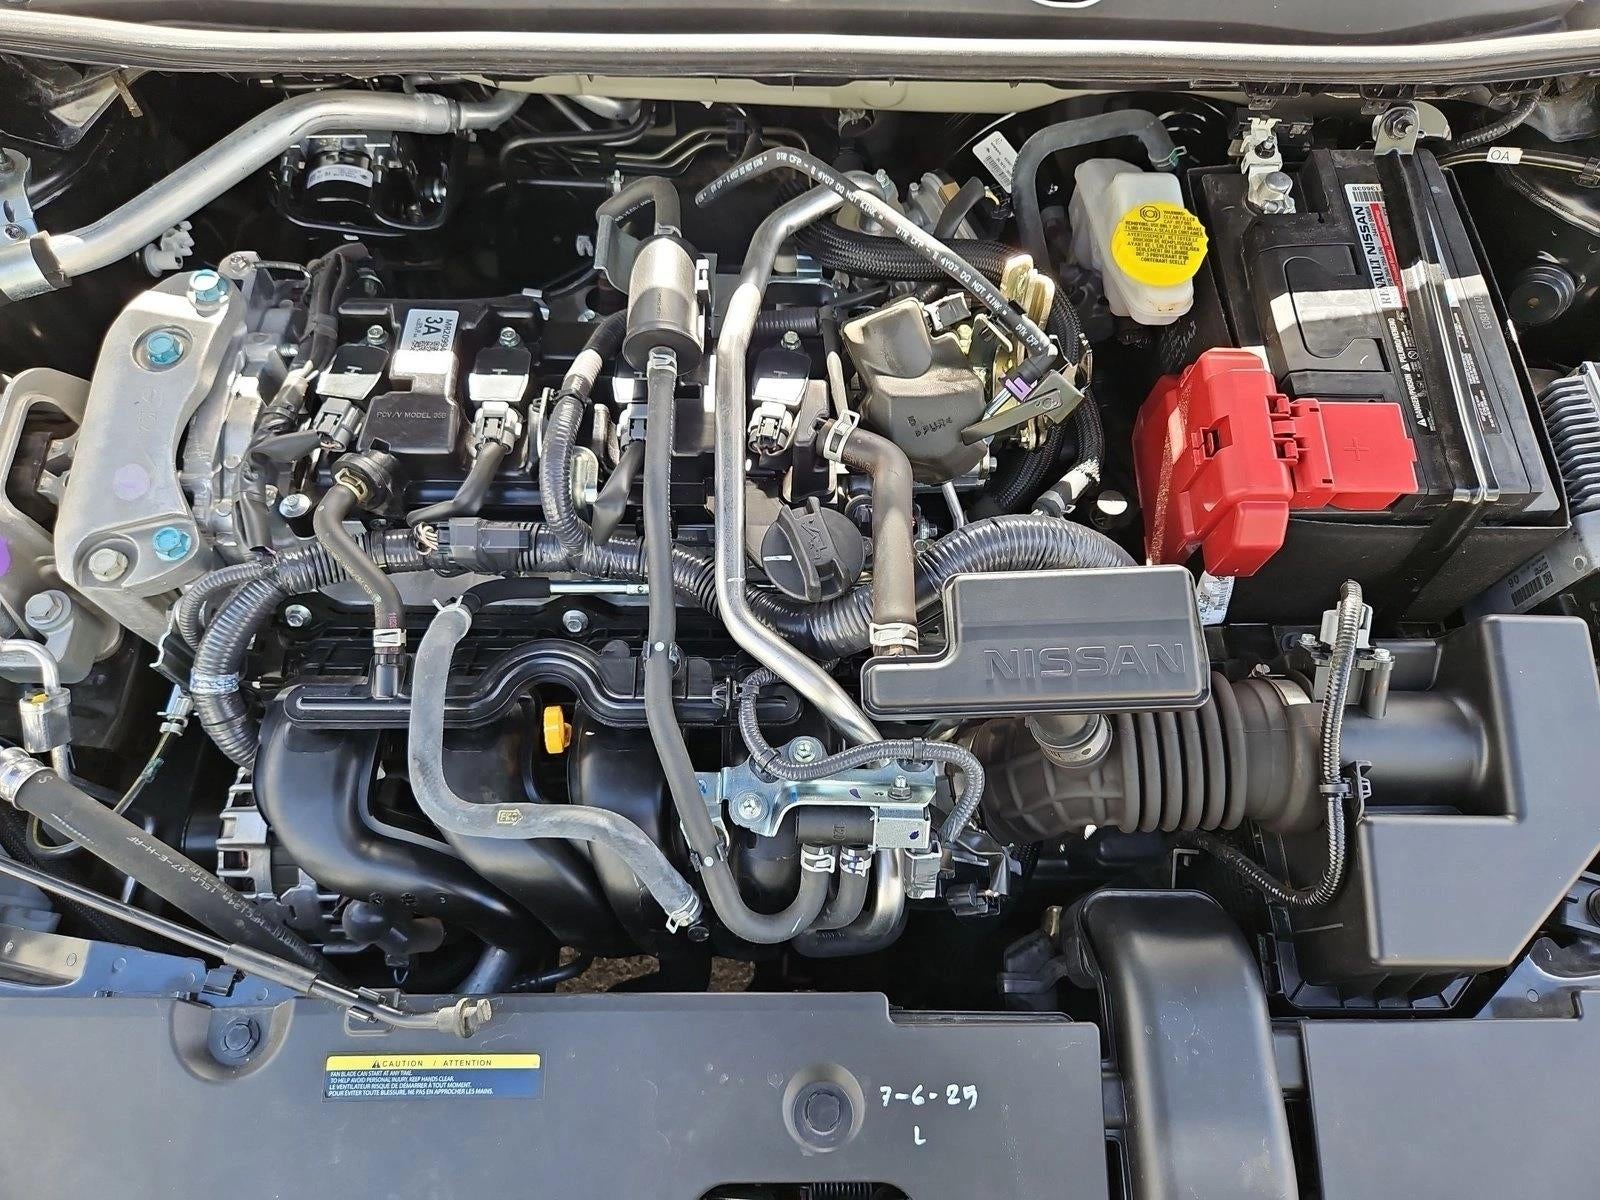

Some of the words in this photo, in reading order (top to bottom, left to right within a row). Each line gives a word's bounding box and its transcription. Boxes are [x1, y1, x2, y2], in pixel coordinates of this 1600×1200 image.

[846, 190, 860, 203] NOT
[1353, 206, 1377, 256] NISSAN
[959, 271, 971, 283] DO
[971, 281, 986, 295] NOT
[985, 293, 1002, 312] KINK
[422, 316, 444, 336] 3A
[404, 411, 432, 419] MODEL
[984, 643, 1186, 680] NISSAN
[443, 1059, 492, 1067] ATTENTION
[914, 1125, 927, 1146] L
